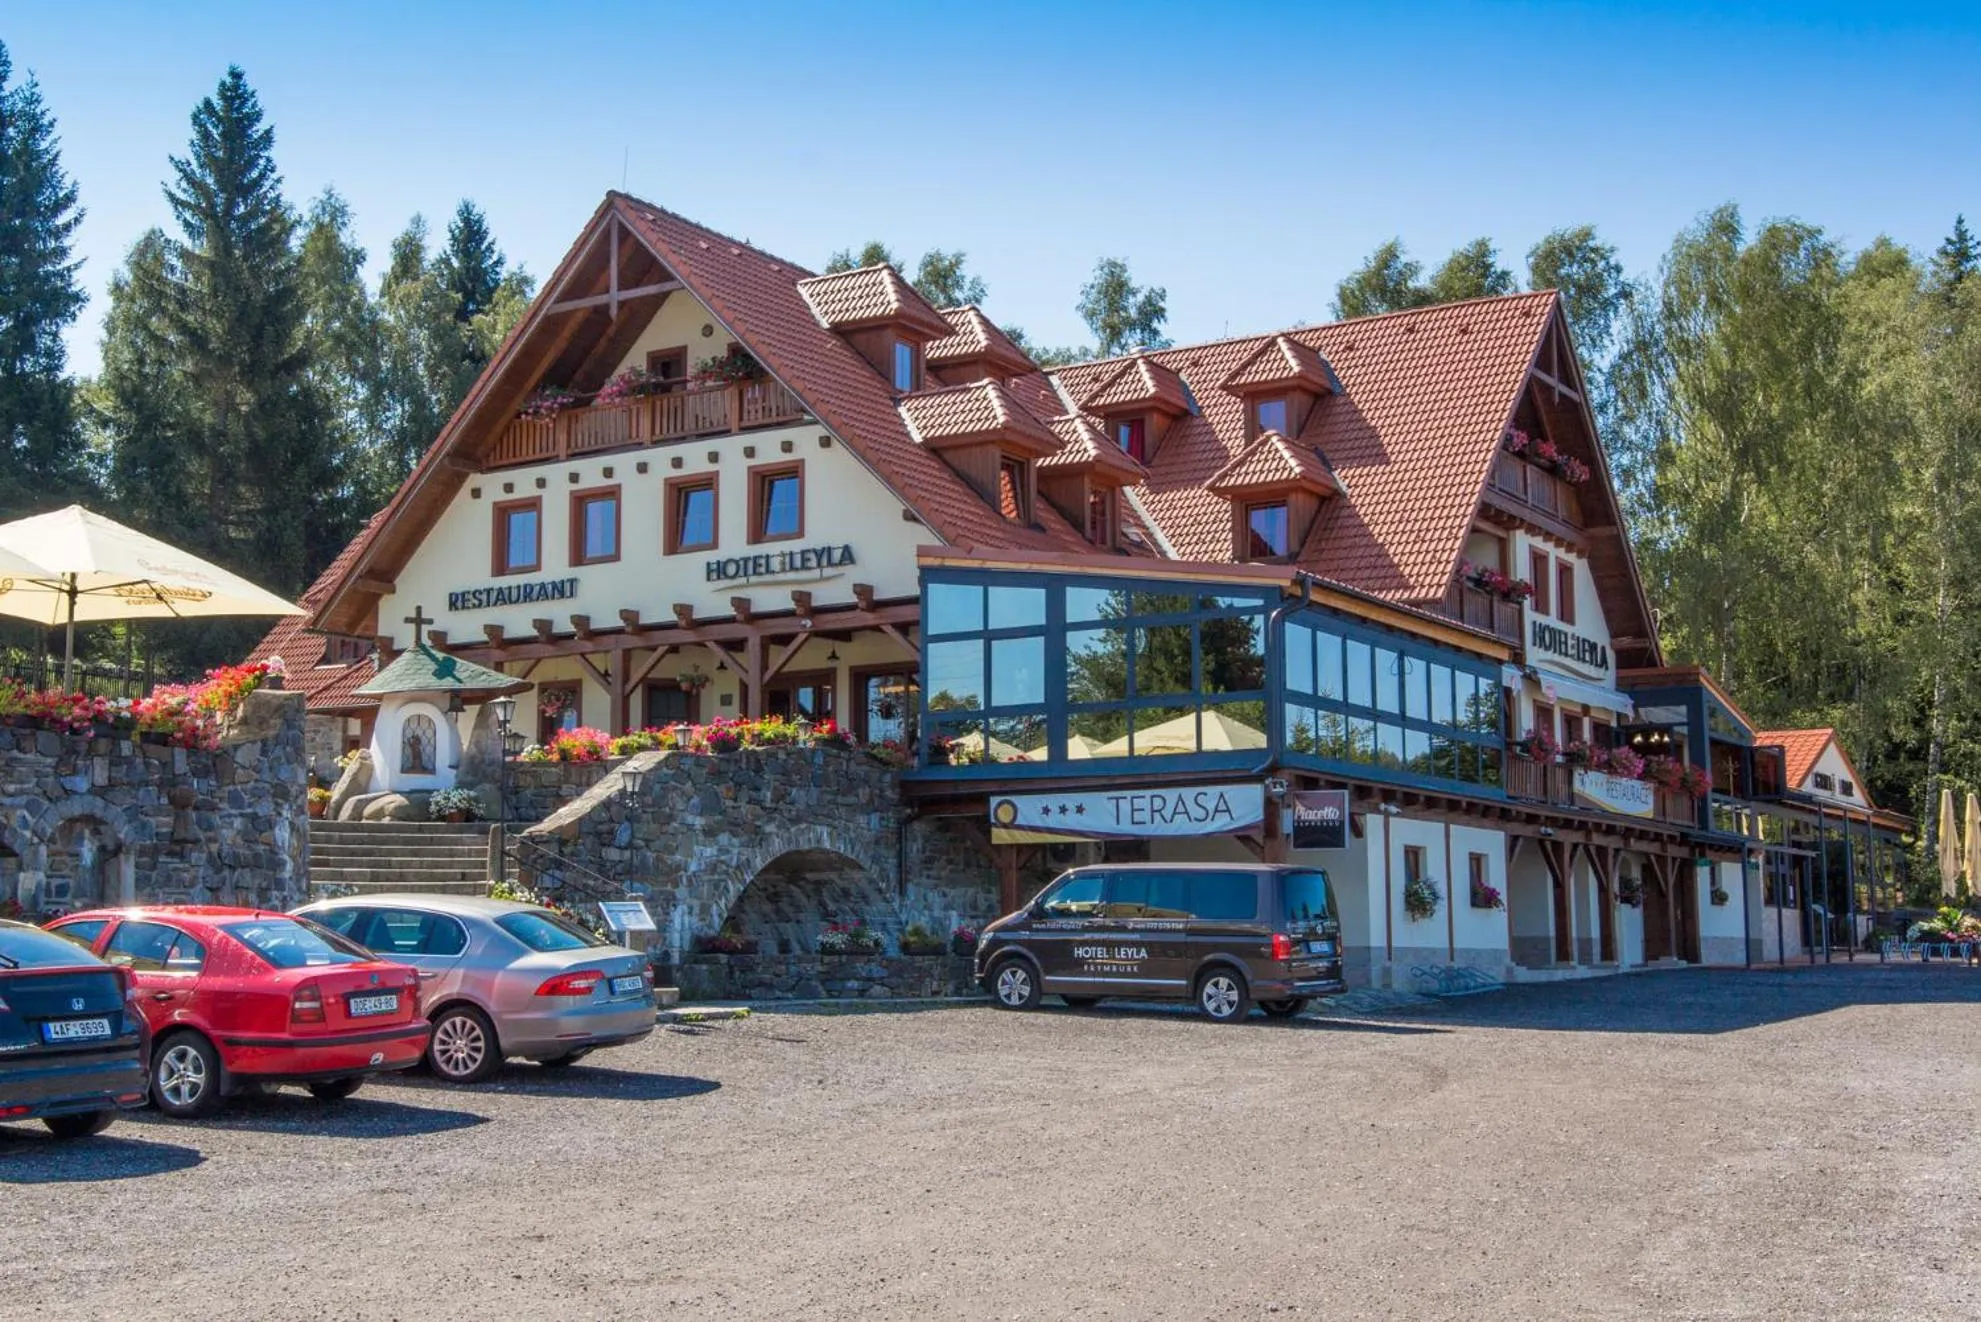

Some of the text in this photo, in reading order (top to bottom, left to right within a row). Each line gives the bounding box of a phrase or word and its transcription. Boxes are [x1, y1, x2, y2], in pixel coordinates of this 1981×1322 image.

[706, 544, 856, 581] HOTEL LEYLA
[448, 577, 578, 612] RESTAURANT
[1532, 620, 1609, 671] HOTEL LEYLA
[1107, 792, 1234, 826] TERASA
[1074, 946, 1148, 959] HOTEL LEYLA
